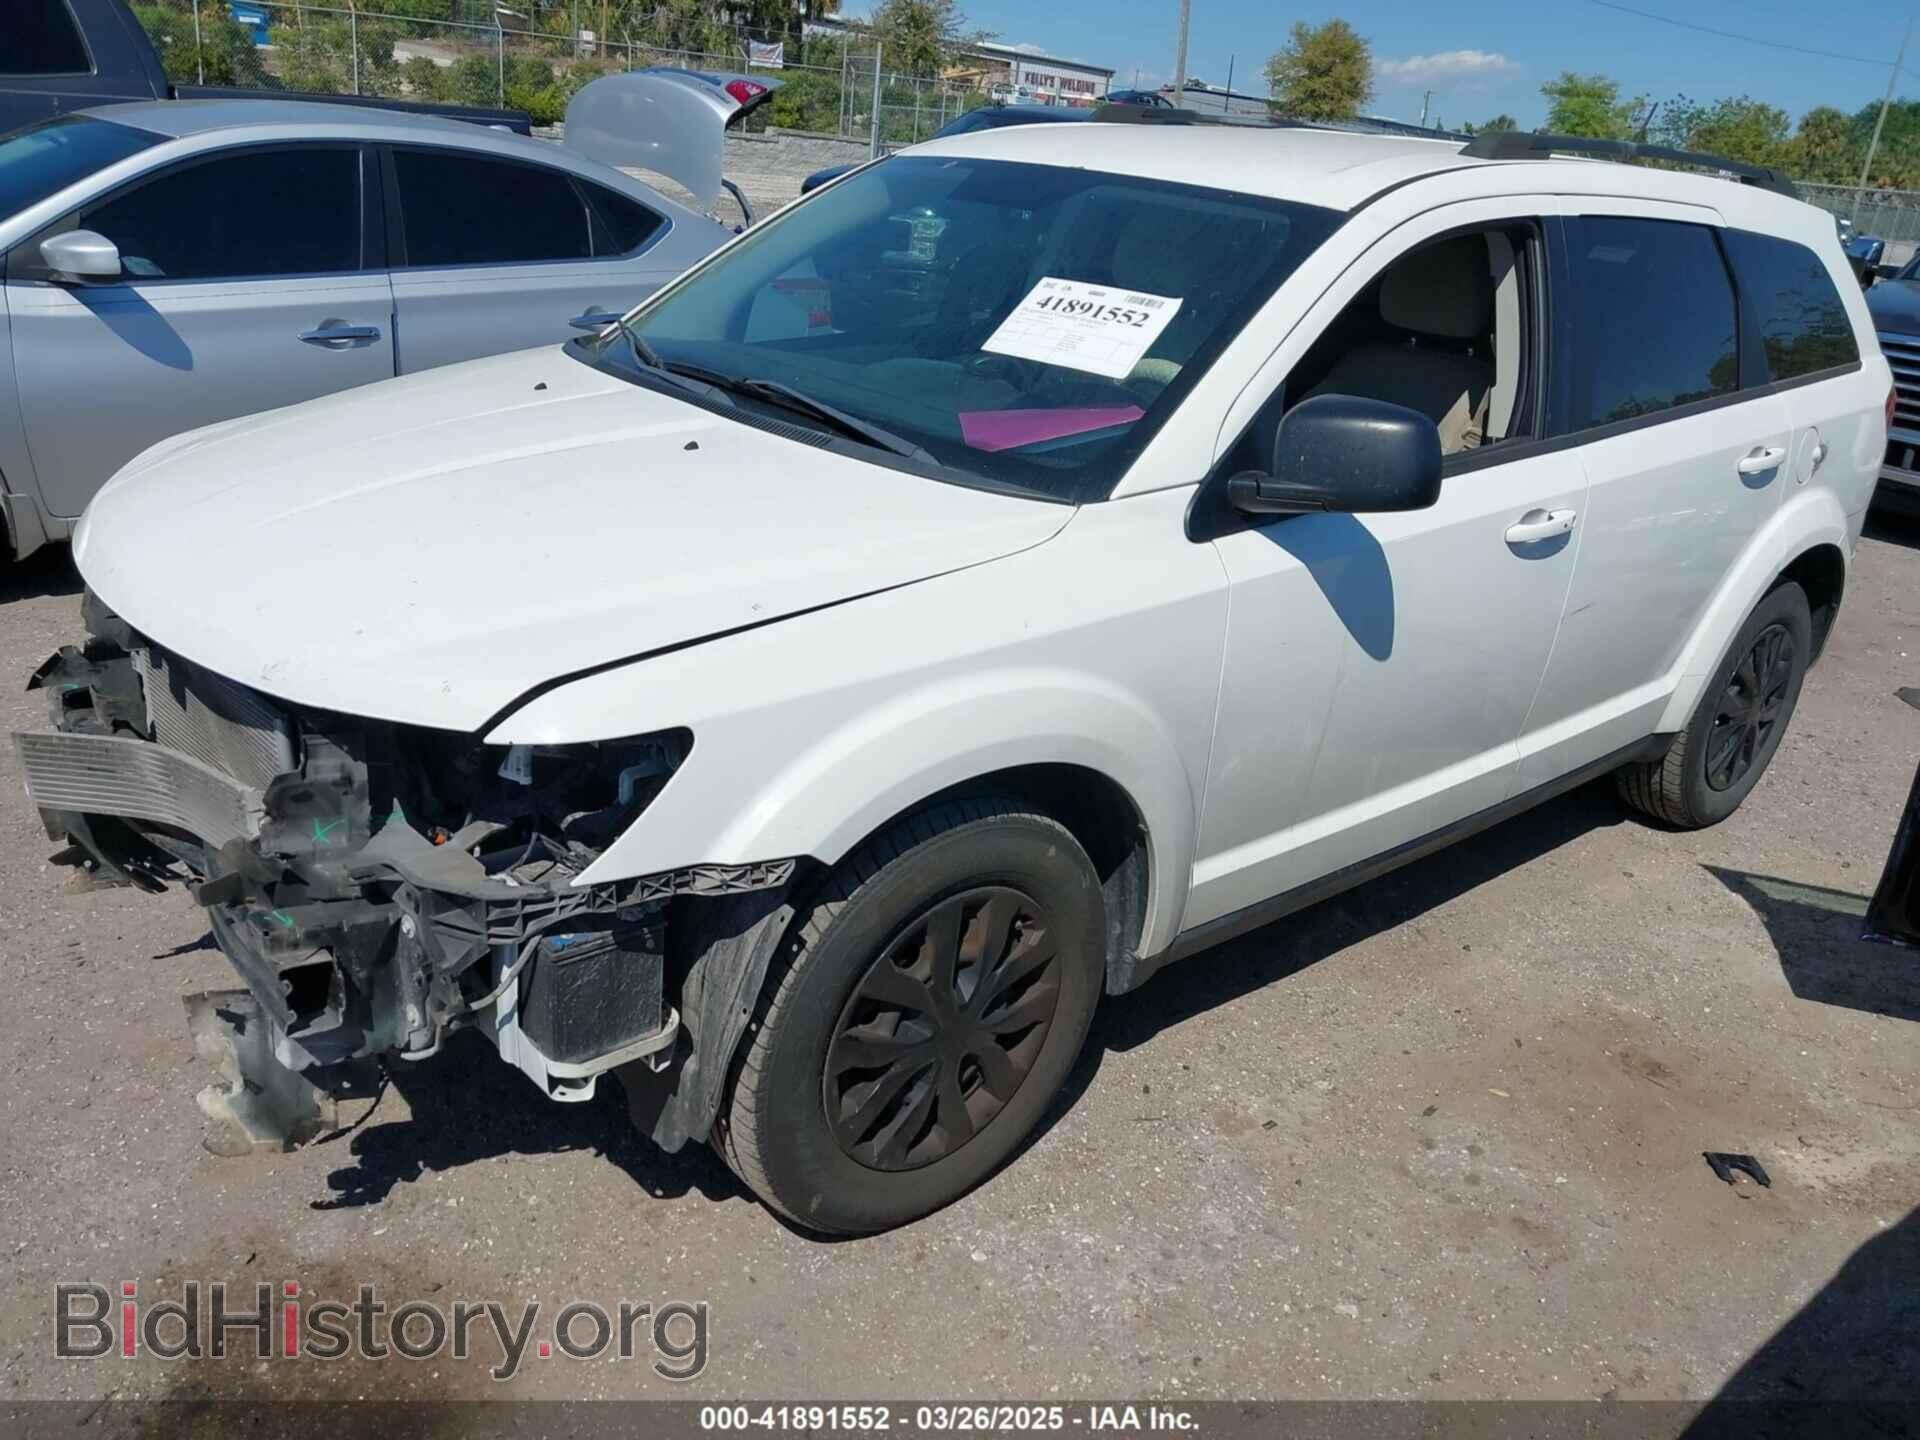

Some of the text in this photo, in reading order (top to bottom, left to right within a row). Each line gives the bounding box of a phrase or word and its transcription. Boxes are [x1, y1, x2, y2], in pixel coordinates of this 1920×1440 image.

[1025, 72, 1096, 94] KELLY'S WELDING
[1036, 295, 1150, 328] 41891552
